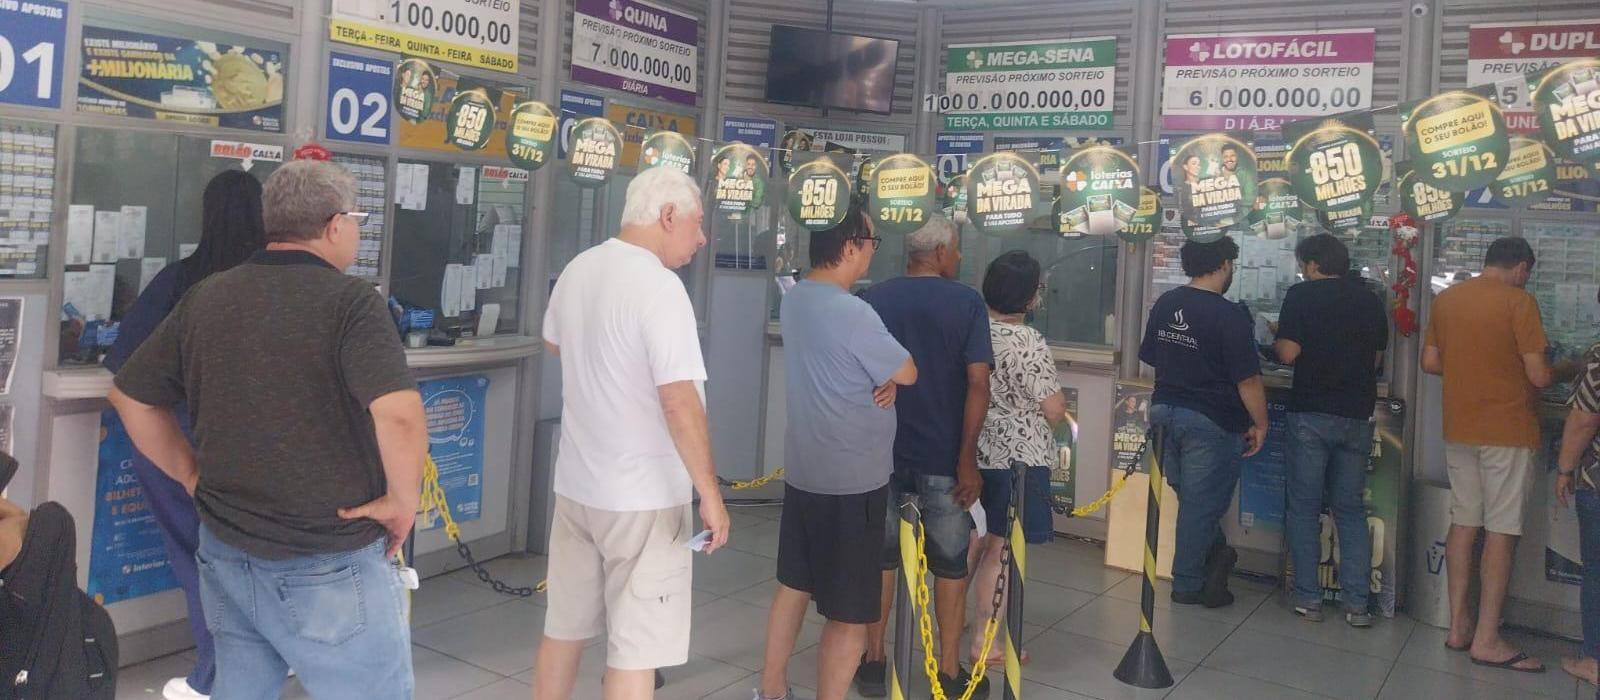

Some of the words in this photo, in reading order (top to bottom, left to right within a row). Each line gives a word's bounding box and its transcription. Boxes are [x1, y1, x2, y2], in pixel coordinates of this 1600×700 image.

[21, 2, 63, 19] APOSTAS
[624, 6, 668, 32] QUINA
[336, 25, 367, 41] TERÇA
[375, 33, 401, 48] FEIRA
[407, 40, 440, 55] QUINTA
[448, 48, 472, 61] FEIRA
[480, 54, 513, 69] SÁBADO
[582, 18, 621, 38] PREVISÃO
[623, 30, 657, 48] PRÓXIMO
[659, 40, 691, 57] SORTEIO
[1530, 31, 1600, 51] DUPL
[987, 47, 1095, 66] MEGA-SENA
[1213, 38, 1338, 58] LOTOFÁCIL
[591, 42, 691, 84] 7.000.000,00
[1176, 67, 1237, 79] PREVISÃO
[1241, 66, 1299, 78] PRÓXIMO
[1302, 66, 1360, 78] SORTEIO
[622, 79, 648, 95] DIÁRIA
[956, 73, 1005, 85] PREVISÃO
[1009, 71, 1055, 83] PRÓXIMO
[1059, 70, 1104, 81] SORTEIO
[1189, 87, 1361, 111] 6.000.000,00
[330, 88, 388, 138] 02
[457, 103, 487, 131] 850
[947, 115, 989, 130] TERÇA,
[992, 115, 1038, 127] QUINTA
[1041, 115, 1050, 127] E
[1053, 113, 1107, 126] SÁBADO
[1421, 119, 1458, 136] COMPRE
[1461, 111, 1485, 123] AQUI
[1435, 132, 1450, 141] SEU
[1453, 121, 1488, 136] BOLÃO!
[813, 131, 834, 140] ESTA
[835, 132, 854, 142] LOJA
[253, 150, 281, 160] CAIXA
[512, 143, 543, 162] 31/12
[1442, 145, 1477, 158] SORTEIO
[1310, 143, 1363, 185] 850
[1432, 152, 1497, 178] 31/12
[1091, 169, 1133, 180] loterias
[718, 178, 753, 191] MEGA
[801, 179, 838, 206] 850
[977, 178, 1031, 197] MEGA
[1091, 179, 1133, 190] CAIXA
[1191, 174, 1240, 195] MEGA
[1315, 175, 1366, 201] MILHÕES
[1503, 179, 1548, 197] 31/12
[977, 197, 991, 214] DA
[991, 193, 1032, 212] VIRADA
[1205, 187, 1242, 205] VIRADA
[800, 206, 835, 219] MILHÕES
[880, 207, 923, 223] 31/12
[1114, 432, 1146, 443] MEGA
